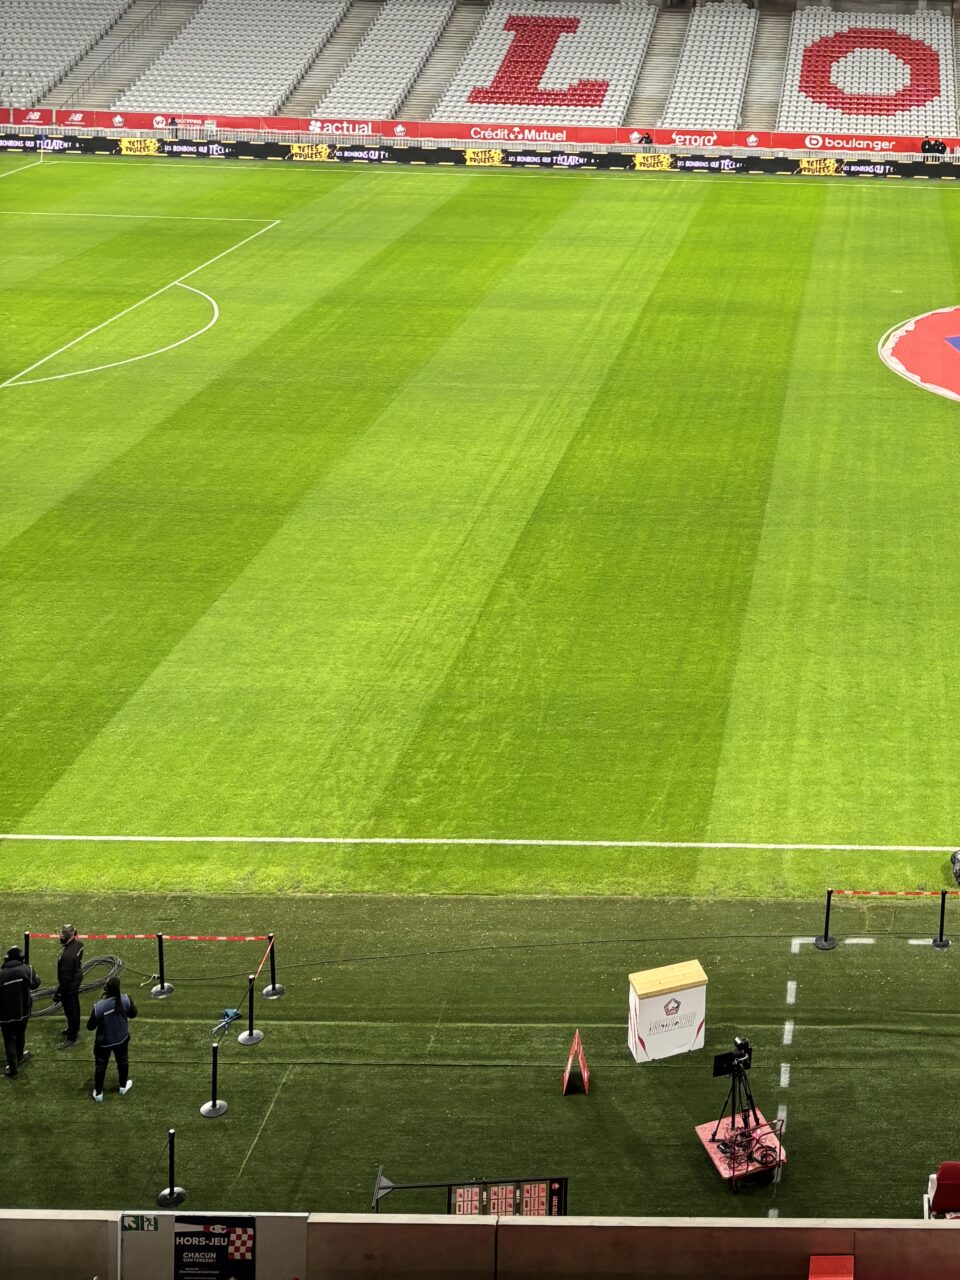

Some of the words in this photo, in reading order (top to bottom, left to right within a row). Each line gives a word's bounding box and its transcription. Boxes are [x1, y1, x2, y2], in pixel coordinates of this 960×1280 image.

[323, 122, 372, 134] actual
[471, 127, 508, 139] Crédit
[524, 130, 566, 141] Mutuel
[825, 136, 896, 149] boulanger
[176, 1237, 228, 1245] HORS-JEU
